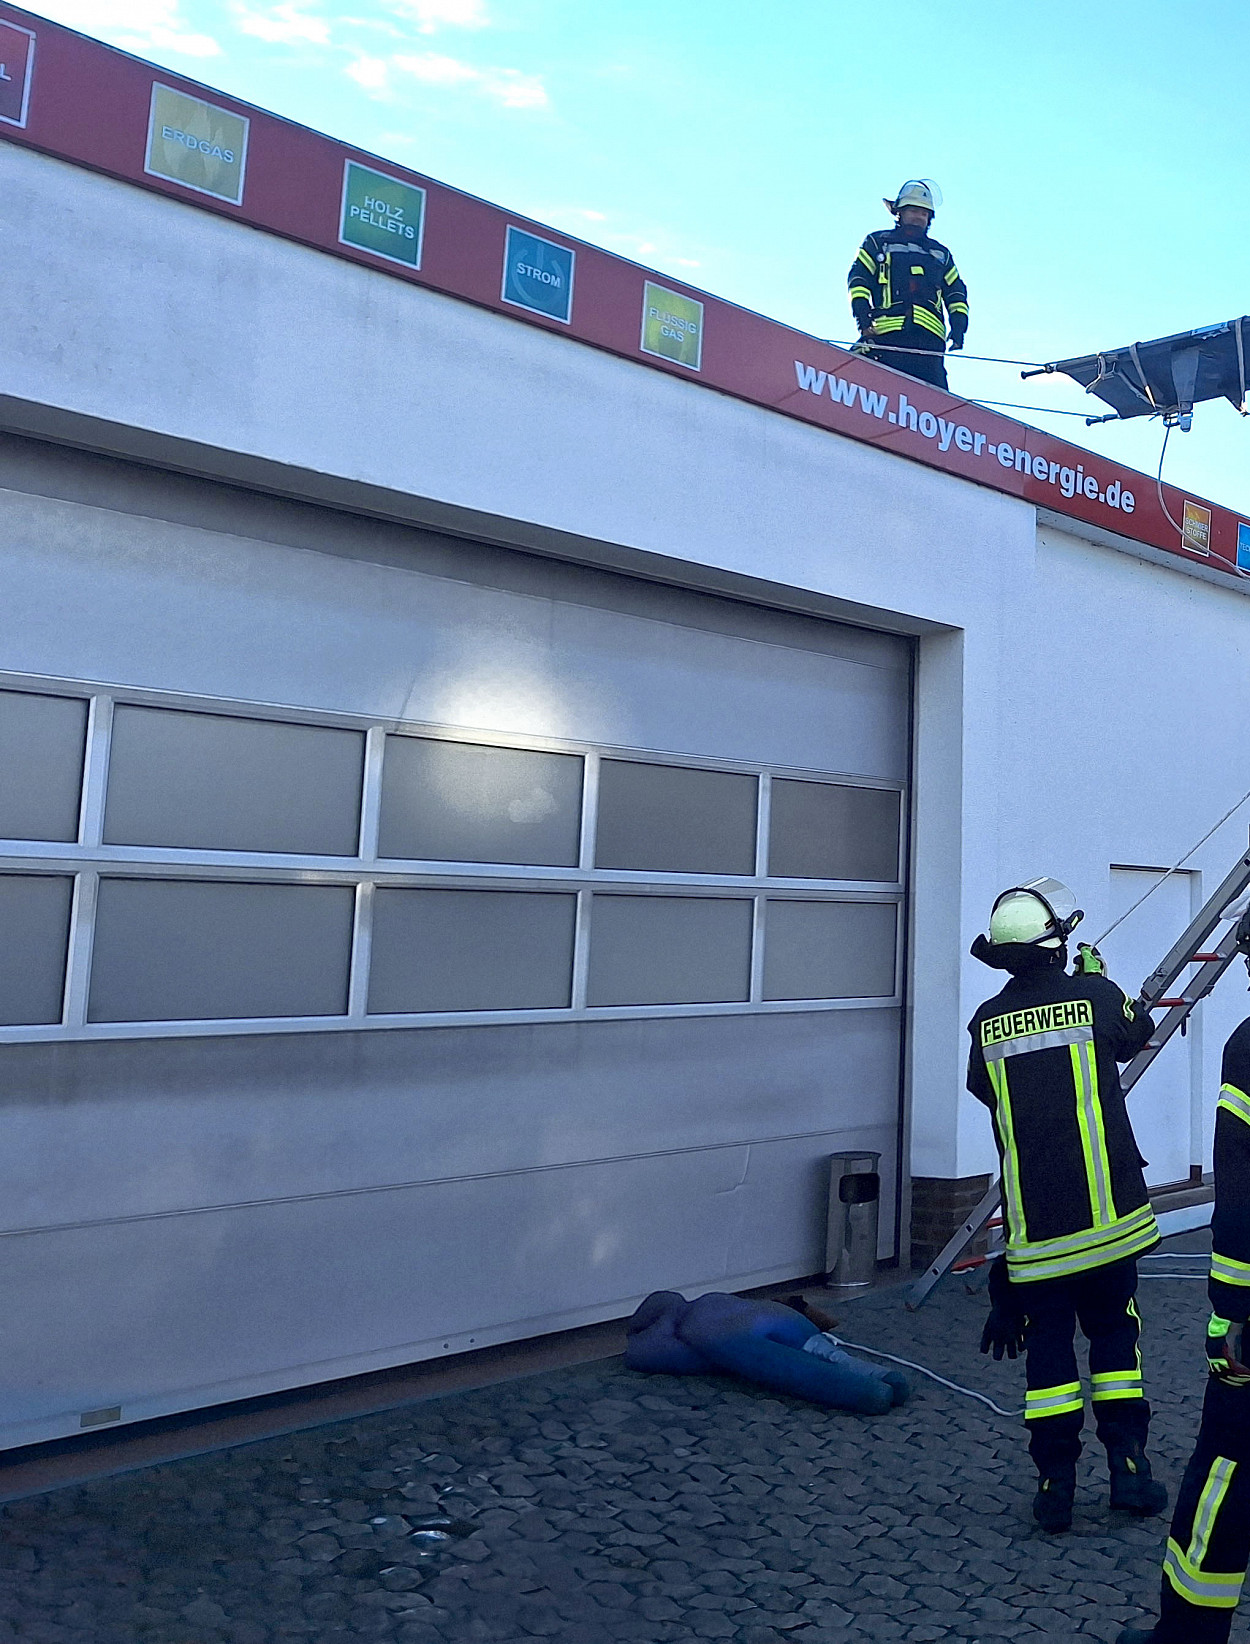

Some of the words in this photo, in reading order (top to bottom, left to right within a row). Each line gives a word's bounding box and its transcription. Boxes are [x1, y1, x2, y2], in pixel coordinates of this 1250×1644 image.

[161, 125, 235, 163] ERDGAS
[350, 205, 415, 239] PELLETS
[364, 195, 404, 221] HOLZ
[516, 261, 561, 288] STROM
[661, 325, 684, 342] GAS
[794, 360, 1135, 513] www.hoyer-energie.de
[983, 1002, 1090, 1043] FEUERWEHR
